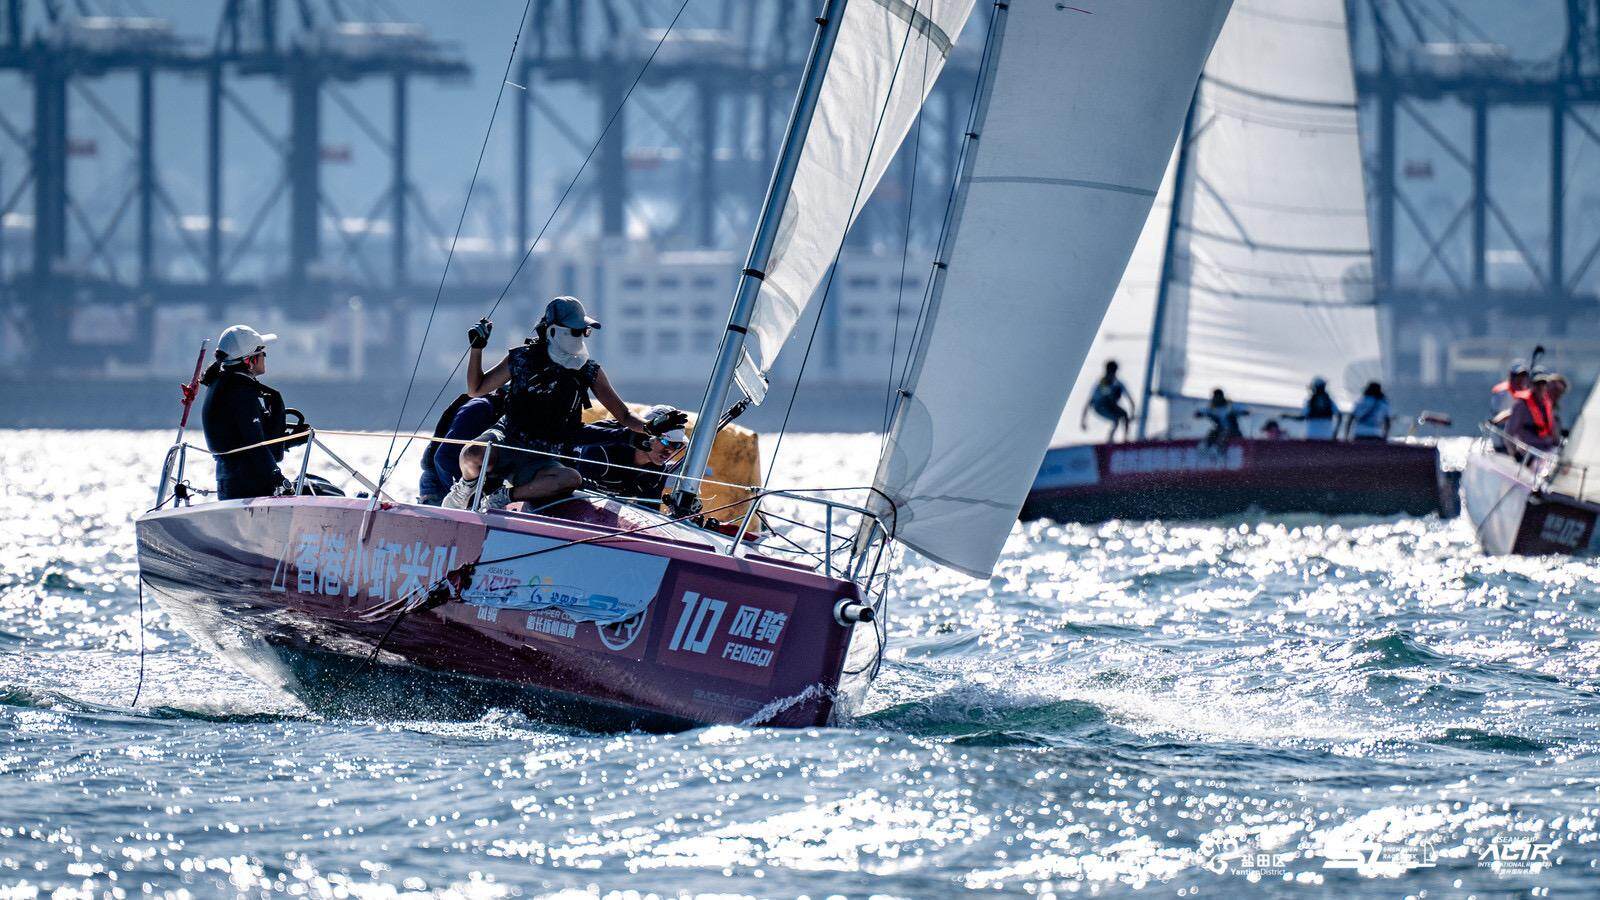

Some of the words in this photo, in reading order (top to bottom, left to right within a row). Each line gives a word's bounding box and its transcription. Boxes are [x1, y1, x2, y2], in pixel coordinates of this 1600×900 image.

[669, 591, 728, 655] 10
[728, 604, 788, 645] 风骑
[721, 641, 775, 667] FENGQI
